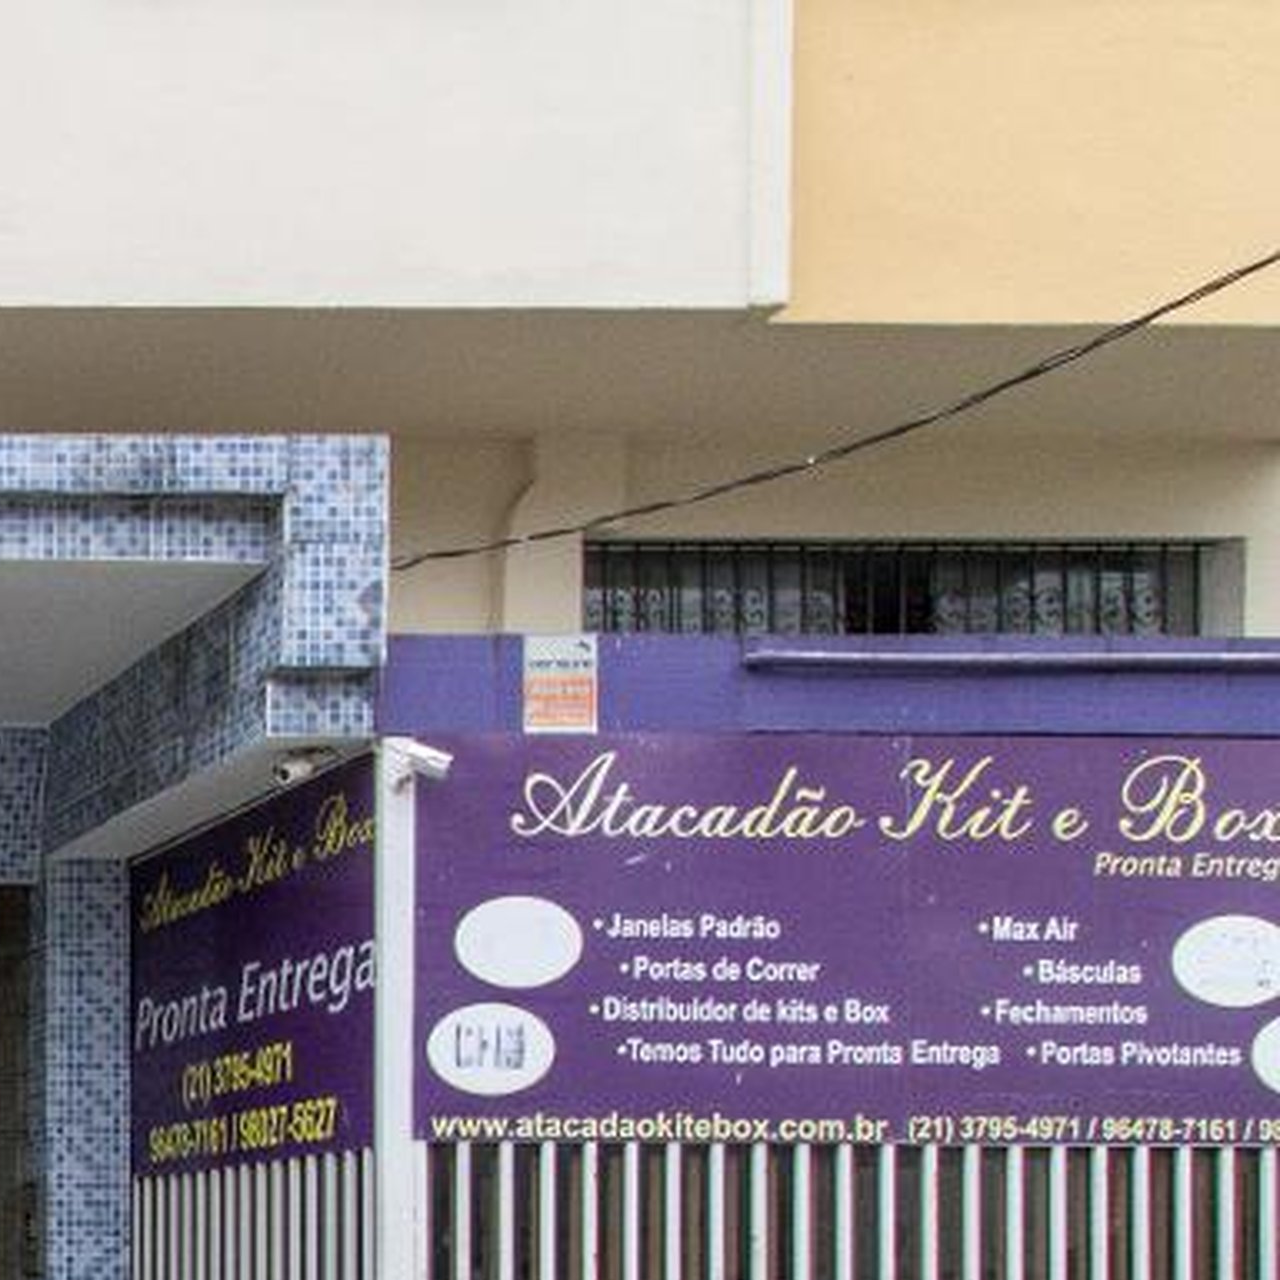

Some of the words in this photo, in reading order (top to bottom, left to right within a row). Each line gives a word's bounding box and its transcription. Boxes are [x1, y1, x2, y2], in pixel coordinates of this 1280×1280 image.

[510, 750, 866, 838] Atacadão
[879, 755, 1033, 841] Kit
[1051, 807, 1089, 840] e
[1118, 755, 1280, 842] Box
[1093, 852, 1183, 878] Pronta
[1192, 852, 1280, 882] Entreg
[606, 913, 693, 939] Janelas
[699, 913, 782, 939] Padrão
[992, 916, 1039, 941] Max
[1043, 916, 1079, 941] Air
[632, 956, 707, 981] Portas
[711, 956, 741, 981] de
[745, 957, 821, 981] Correr
[1038, 959, 1143, 983] Básculas
[136, 986, 229, 1051] Pronta
[236, 939, 375, 1022] Entrega
[602, 997, 738, 1022] Distribuidor
[742, 999, 771, 1022] de
[776, 999, 819, 1023] kits
[823, 1006, 839, 1022] e
[844, 1001, 891, 1023] Box
[994, 999, 1148, 1024] Fechamentos
[625, 1038, 703, 1063] Temos
[707, 1039, 765, 1063] Tudo
[769, 1045, 821, 1068] para
[827, 1039, 904, 1064] Pronta
[910, 1039, 1001, 1070] Entrega
[1040, 1041, 1115, 1065] Portas
[1120, 1041, 1243, 1066] Pivotantes
[431, 1112, 888, 1141] www.atacadaokitebox.com.br
[908, 1116, 954, 1143] (21)
[959, 1116, 1081, 1140] 3795-4971
[1101, 1117, 1237, 1141] 96478-7161
